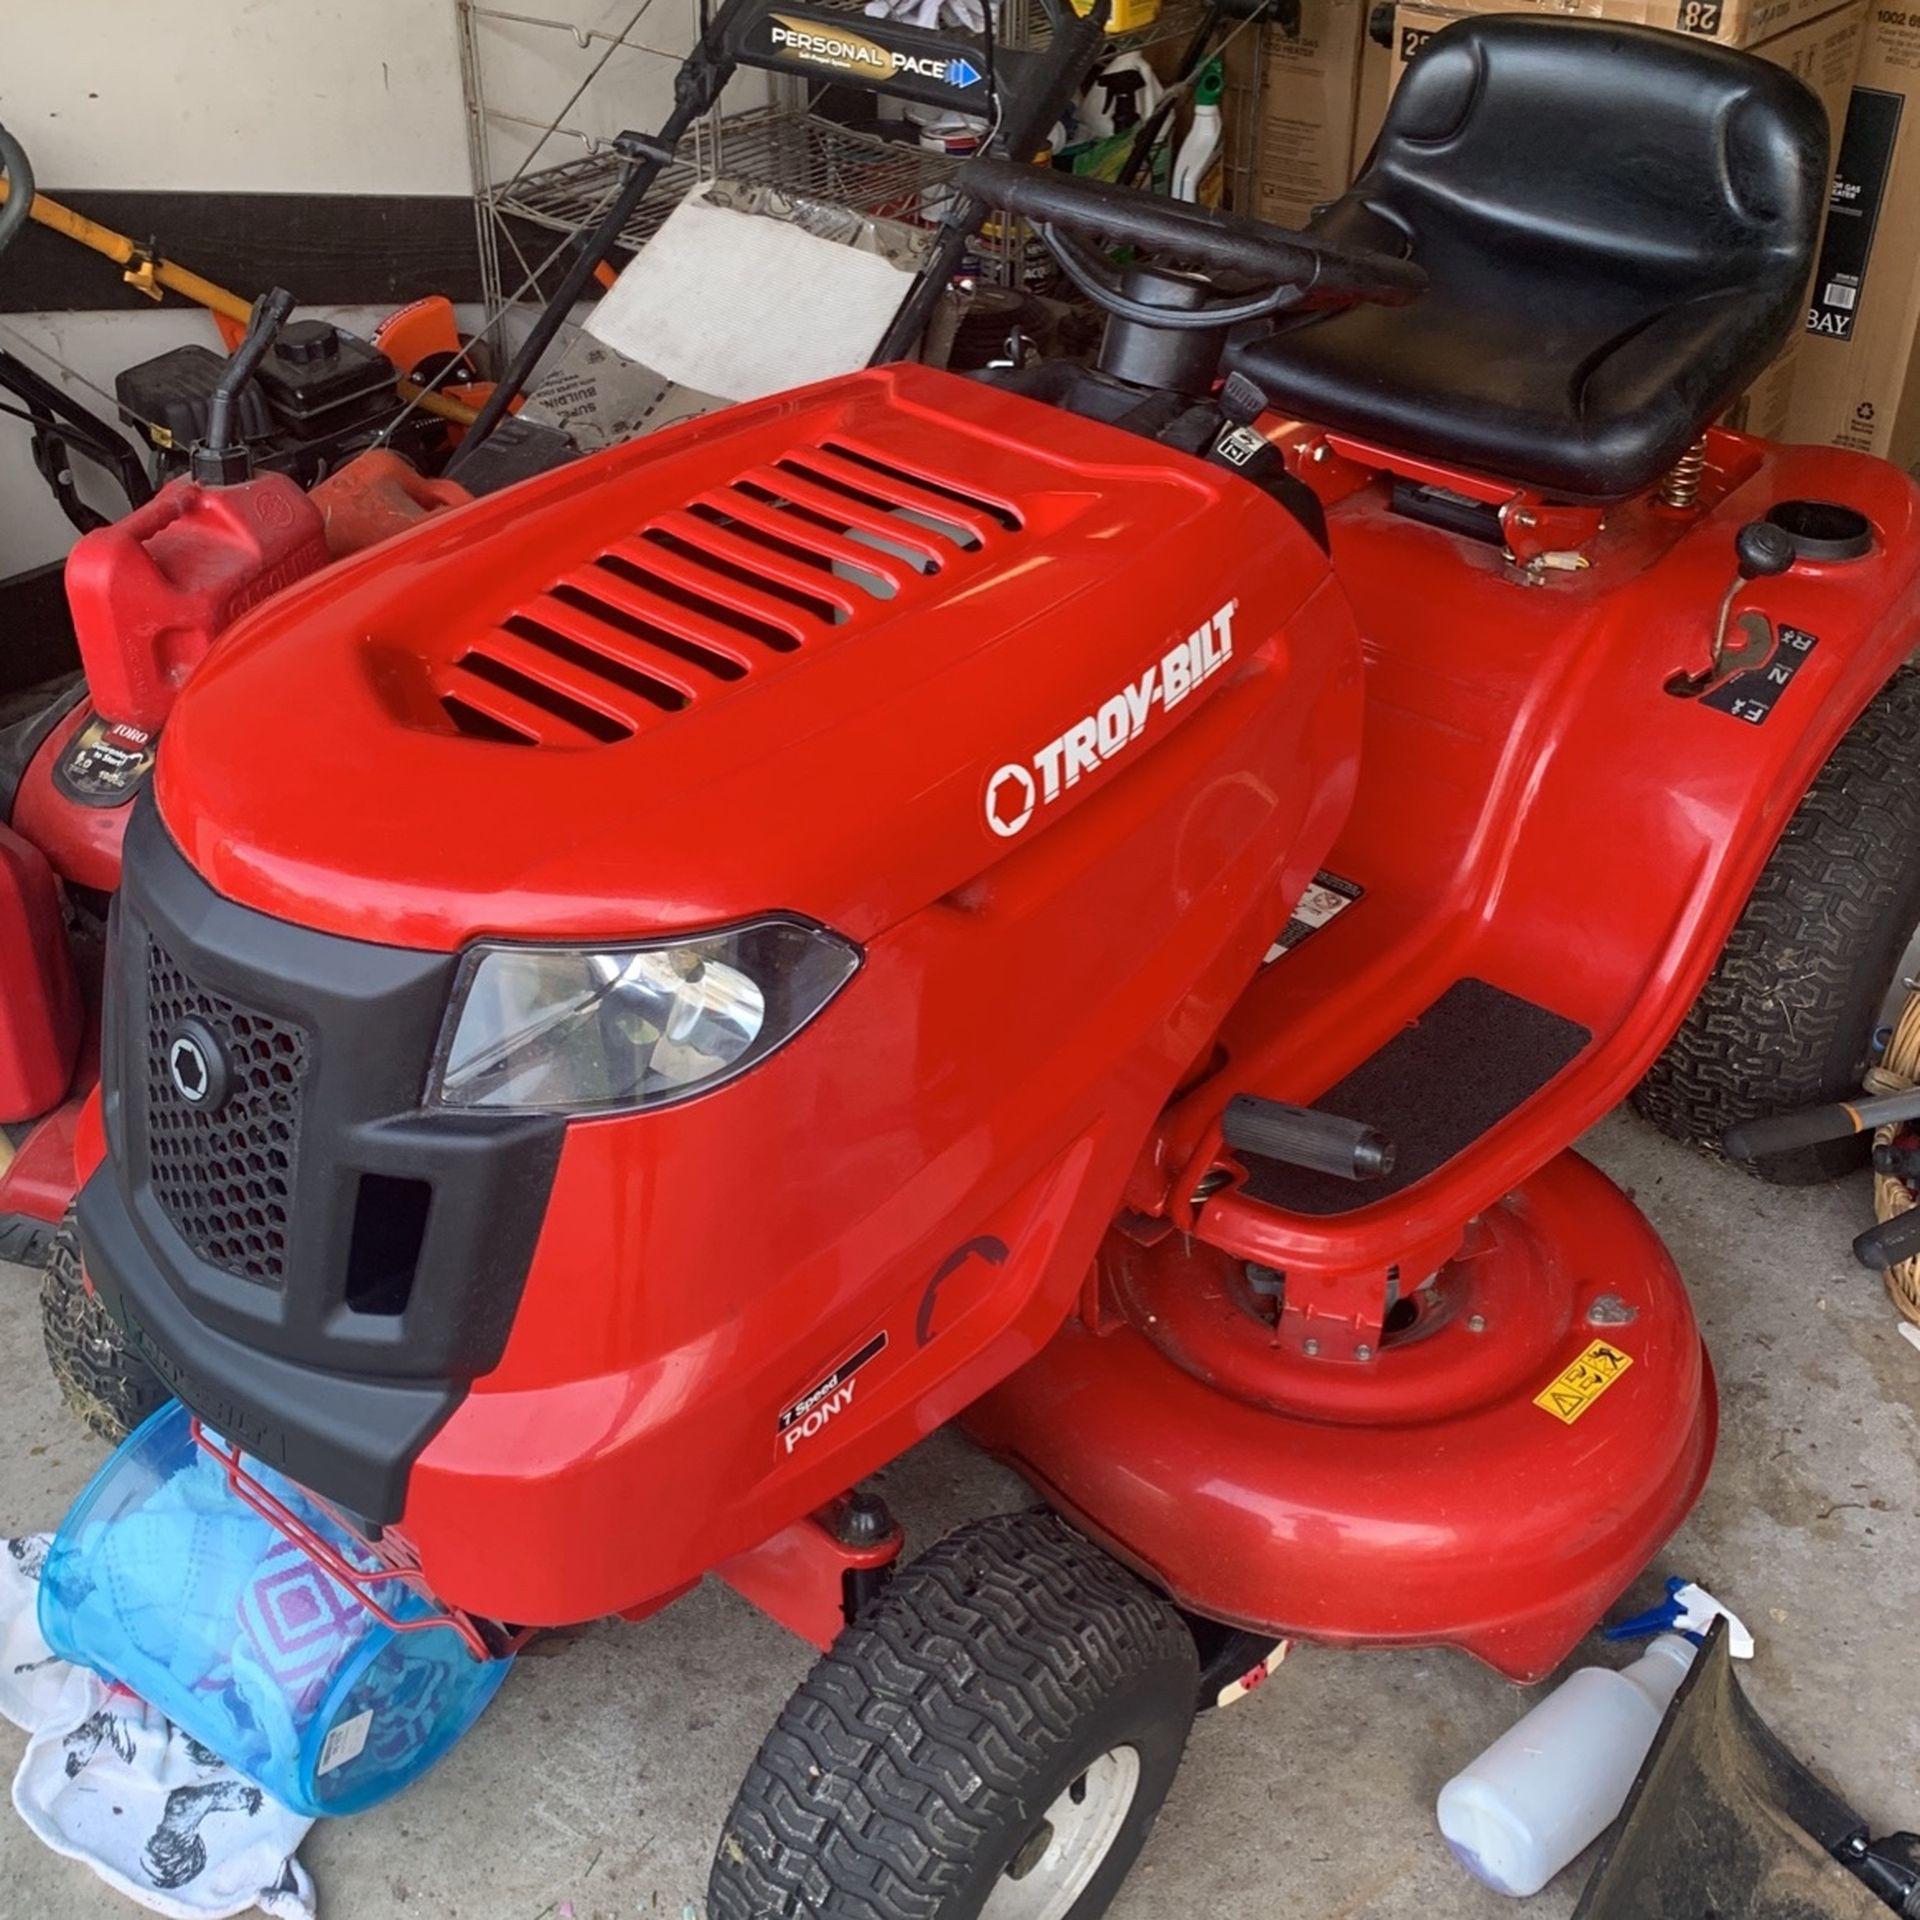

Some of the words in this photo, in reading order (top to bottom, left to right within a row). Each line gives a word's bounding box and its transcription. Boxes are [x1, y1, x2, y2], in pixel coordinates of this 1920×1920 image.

[1685, 1, 1718, 29] 28
[1877, 10, 1906, 25] 1002
[771, 27, 884, 66] PERSONAL
[891, 52, 947, 79] PACE
[1845, 183, 1862, 195] GAS
[1806, 309, 1850, 335] BAY
[1791, 637, 1813, 652] R
[1767, 667, 1789, 685] N
[1033, 600, 1236, 806] TROY-BILT
[1743, 707, 1764, 723] F
[112, 724, 149, 744] TORO
[782, 1412, 792, 1425] 7
[795, 1374, 839, 1417] Speed
[785, 1378, 856, 1455] PONY
